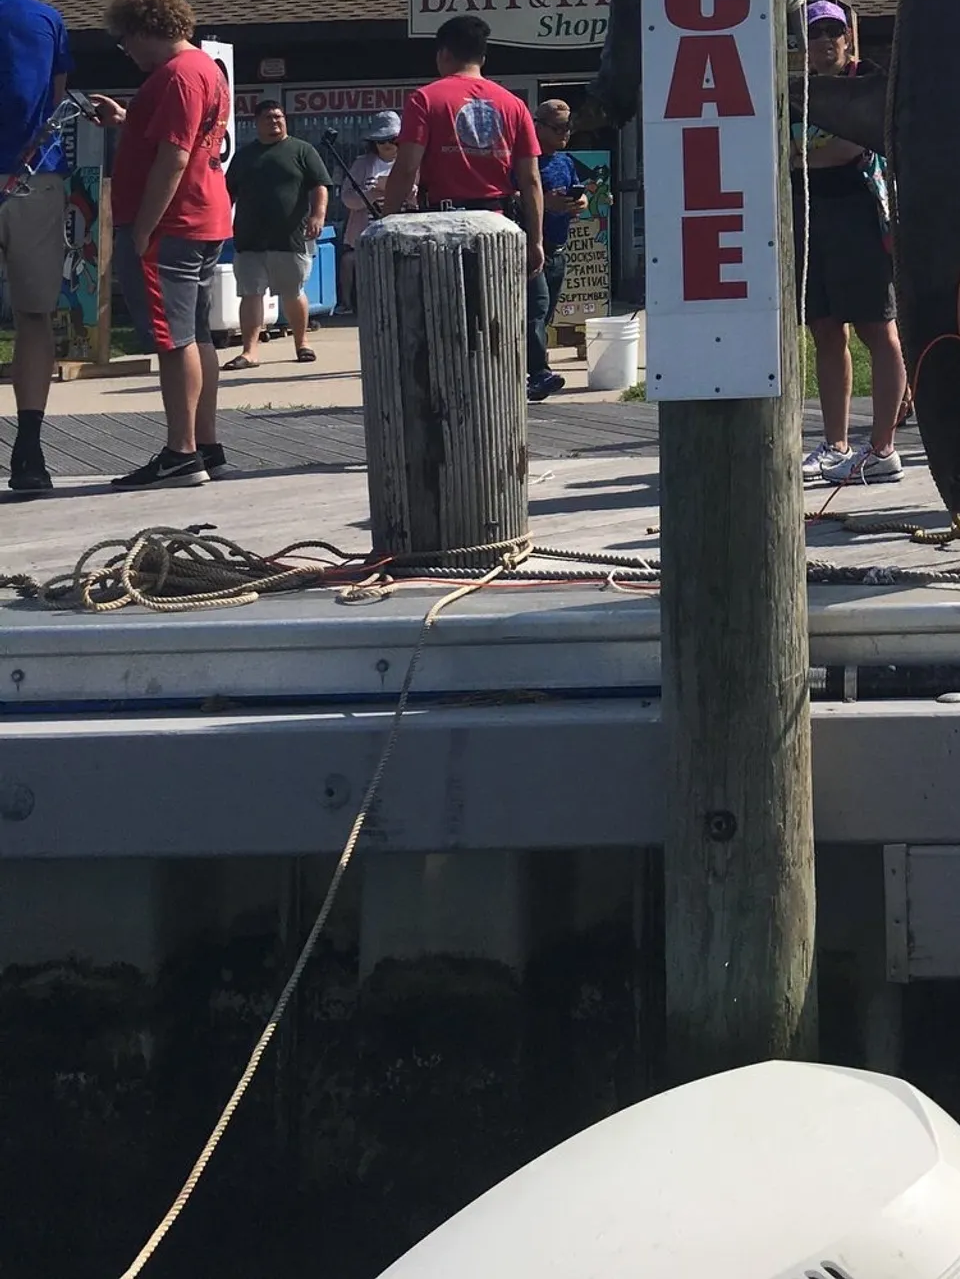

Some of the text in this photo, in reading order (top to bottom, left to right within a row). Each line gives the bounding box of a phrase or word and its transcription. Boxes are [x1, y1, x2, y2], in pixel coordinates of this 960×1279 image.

[537, 13, 607, 42] Shop
[294, 89, 405, 112] SOUVENI
[569, 226, 590, 238] REE
[566, 238, 594, 251] VENT
[566, 277, 608, 289] ESTIVAL
